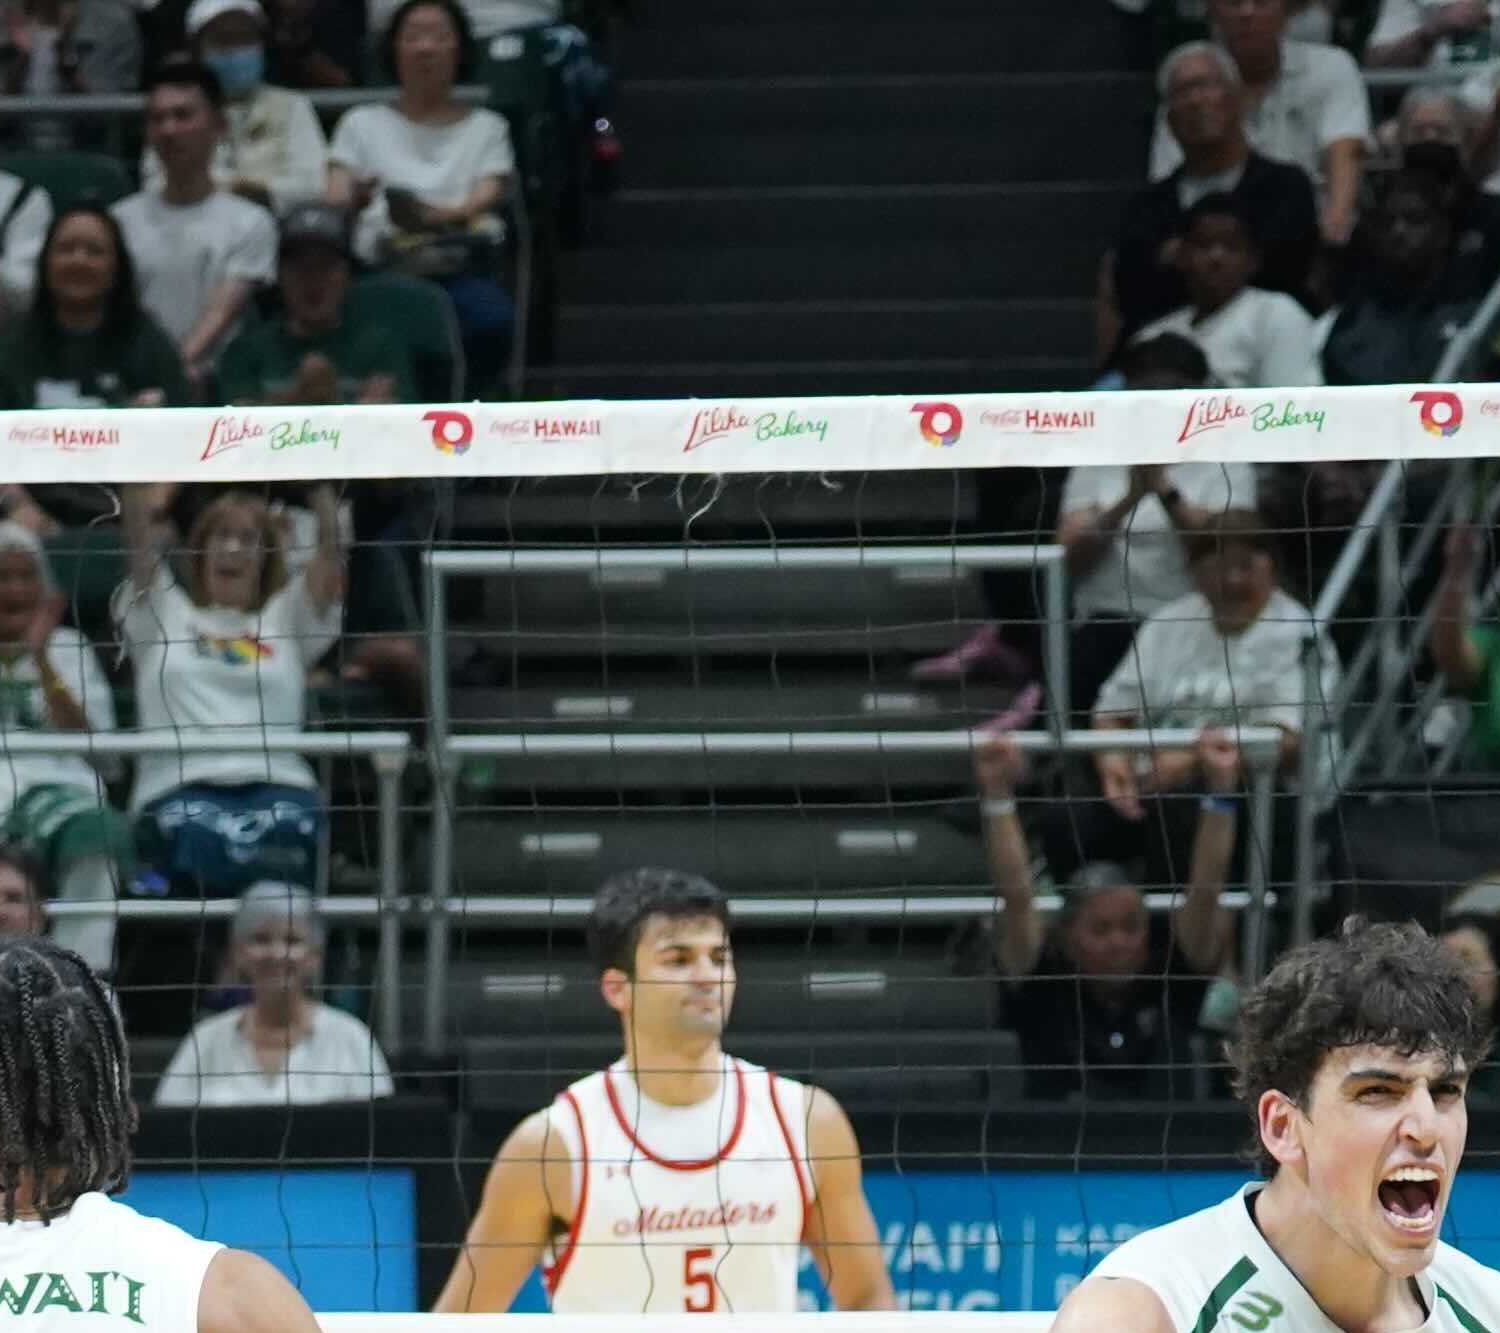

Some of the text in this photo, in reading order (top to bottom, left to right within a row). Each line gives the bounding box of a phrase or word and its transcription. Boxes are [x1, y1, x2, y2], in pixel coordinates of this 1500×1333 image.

[534, 418, 601, 436] HAWAII
[755, 412, 828, 443] Bakery
[1025, 408, 1095, 429] HAWAII
[1252, 401, 1327, 433] Bakery
[53, 426, 120, 445] HAWAII
[269, 421, 341, 452] Bakery
[613, 1199, 778, 1237] Matadors
[684, 1247, 717, 1313] 5
